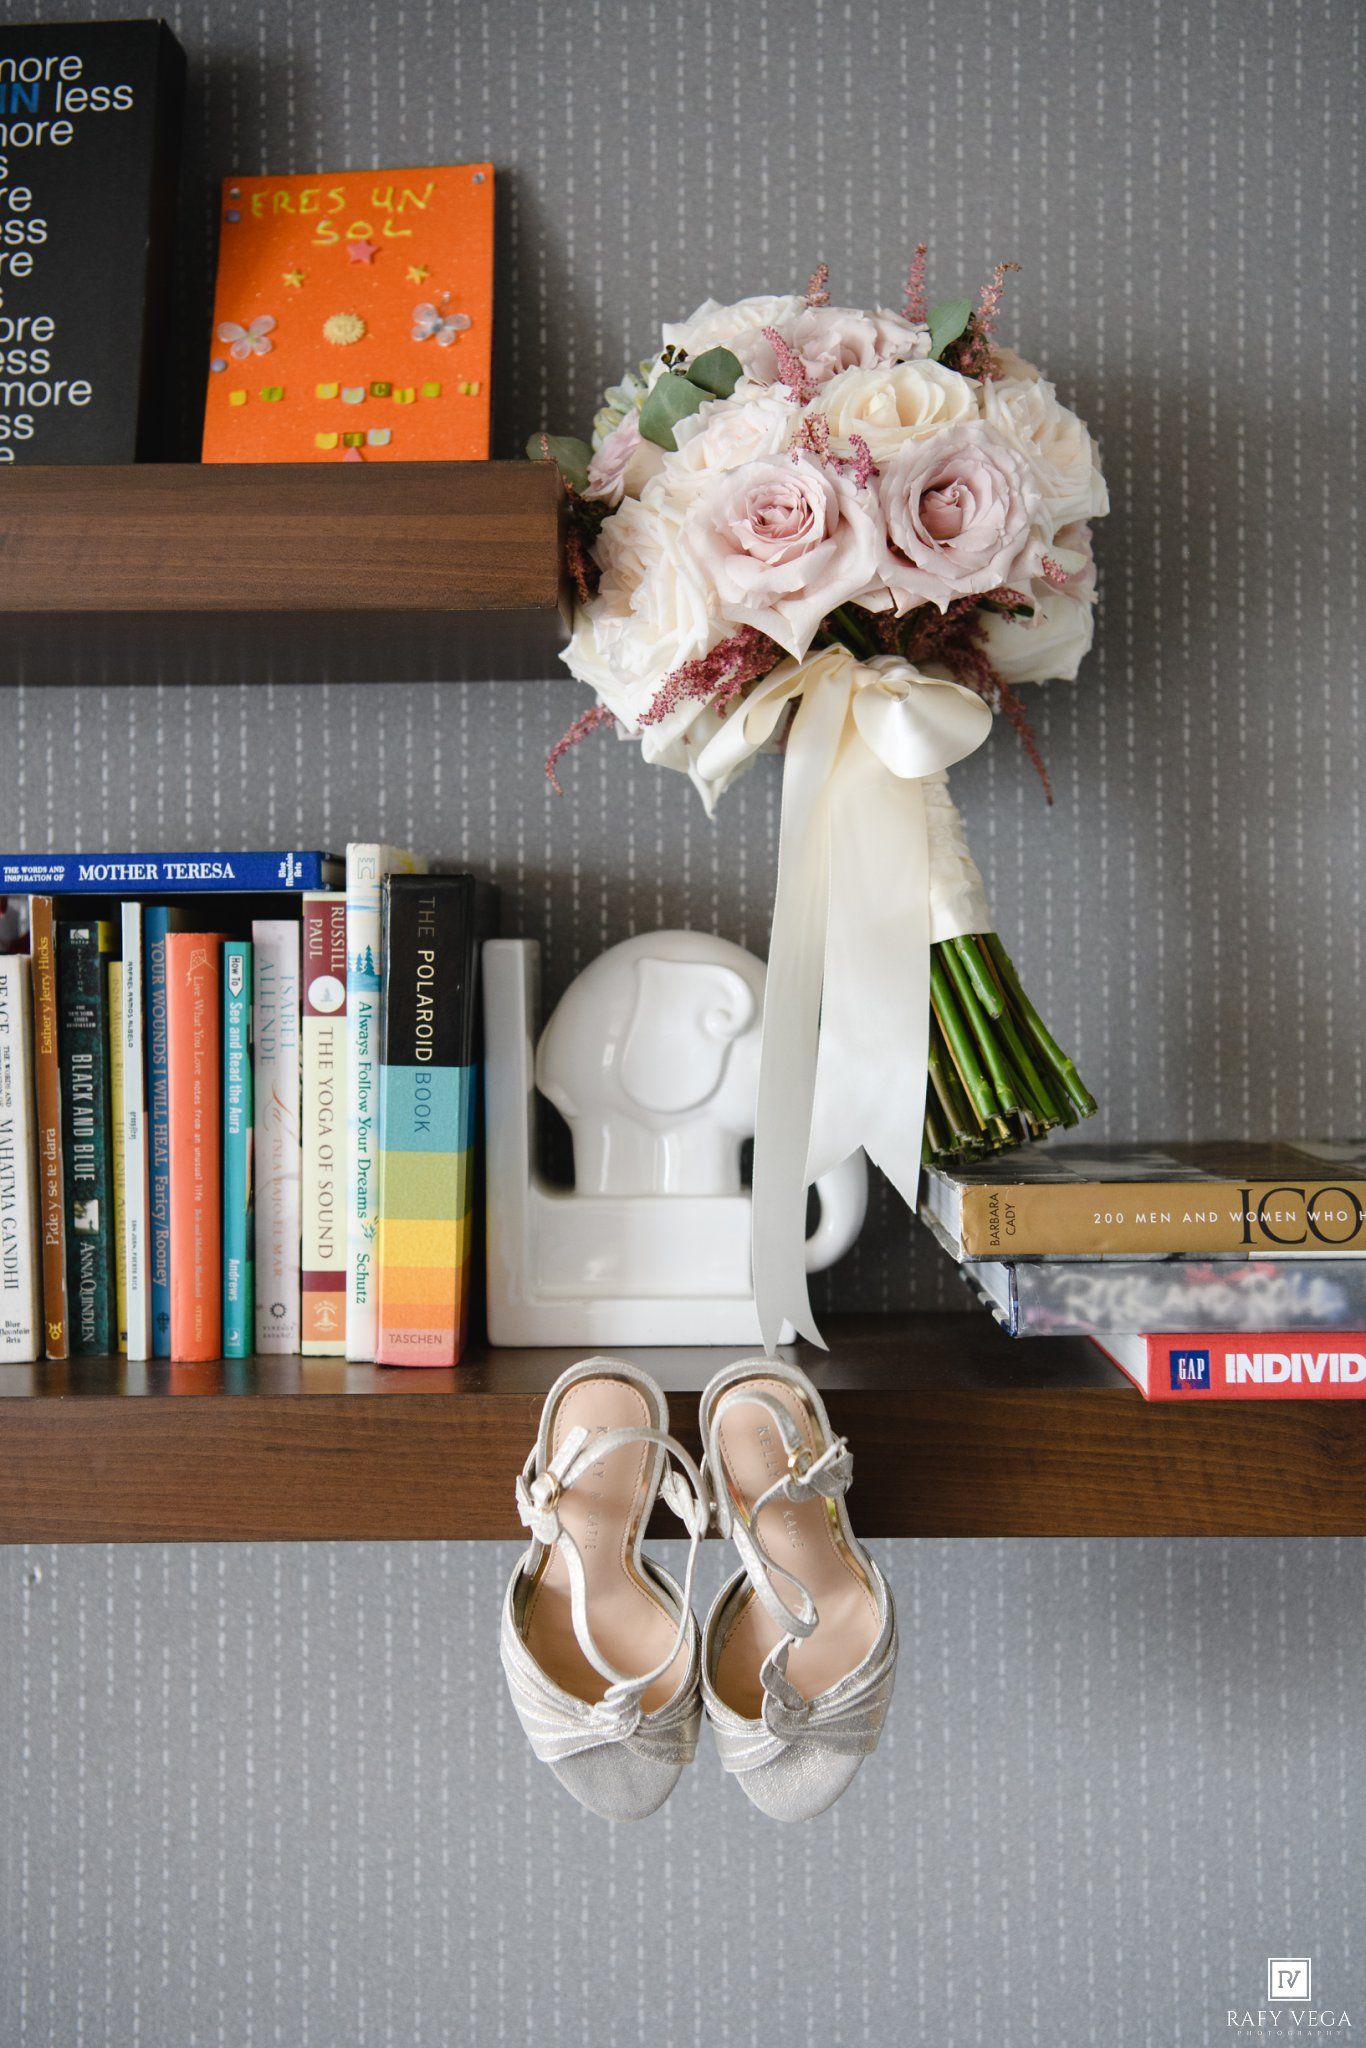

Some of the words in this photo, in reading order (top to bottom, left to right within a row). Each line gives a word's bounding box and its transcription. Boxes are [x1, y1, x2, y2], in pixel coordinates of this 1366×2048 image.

[56, 81, 134, 113] less
[0, 120, 74, 147] ore
[251, 186, 346, 217] ERES
[311, 219, 412, 245] SOL
[0, 380, 92, 407] more
[3, 866, 19, 874] THE
[21, 866, 48, 874] WORDS
[4, 874, 52, 882] INSPIRATION
[78, 864, 159, 882] MOTHER
[163, 862, 236, 880] TERESA
[417, 895, 436, 938] THE
[38, 936, 49, 970] Hicks
[308, 918, 324, 960] PAUL
[330, 906, 346, 972] RUSSILL
[151, 940, 166, 985] YOUR
[231, 957, 241, 974] How
[39, 972, 52, 1002] Jerry
[193, 976, 204, 998] Live
[231, 977, 241, 988] To
[193, 1000, 205, 1027] What
[228, 1002, 243, 1024] See
[259, 958, 277, 1067] ALLENDE
[279, 976, 296, 1053] ISABEL
[415, 950, 435, 1061] POLAROID
[41, 1016, 52, 1054] Esther
[152, 988, 167, 1065] WOUNDS
[194, 1029, 205, 1049] You
[229, 1027, 243, 1049] and
[356, 1001, 373, 1056] Always
[194, 1051, 204, 1076] Love
[318, 1027, 334, 1069] THE
[72, 1054, 94, 1101] BLACK
[229, 1052, 243, 1082] Read
[153, 1079, 168, 1120] WILL
[193, 1080, 202, 1105] notes
[229, 1085, 243, 1104] the
[357, 1062, 372, 1113] Follow
[414, 1072, 432, 1132] BOOK
[73, 1107, 94, 1136] AND
[194, 1109, 203, 1130] from
[229, 1107, 243, 1134] Aura
[318, 1078, 334, 1137] YOGA
[154, 1124, 168, 1167] HEAL
[357, 1117, 372, 1153] Your
[0, 1119, 15, 1211] MAHATMA
[47, 1164, 57, 1177] te
[74, 1144, 95, 1181] BLUE
[194, 1147, 203, 1181] unusual
[318, 1145, 334, 1172] OF
[47, 1181, 57, 1197] se
[195, 1184, 204, 1202] life
[357, 1159, 372, 1219] Dreams
[48, 1200, 61, 1211] y
[318, 1181, 334, 1259] SOUND
[990, 1193, 1000, 1246] BARBARA
[1005, 1203, 1016, 1236] CADY
[1093, 1212, 1124, 1224] 200
[1135, 1212, 1172, 1223] MEN
[1183, 1212, 1218, 1223] AND
[1229, 1211, 1297, 1222] WOMEN
[1306, 1210, 1349, 1221] WHO
[1237, 1187, 1364, 1245] ICO
[45, 1213, 59, 1245] Pide
[1, 1217, 19, 1290] GANDHI
[228, 1259, 241, 1301] Andrews
[356, 1253, 371, 1304] Schutz
[389, 1334, 442, 1344] TASCHEN
[1178, 1358, 1206, 1380] GAP
[1225, 1353, 1366, 1383] INDIVID
